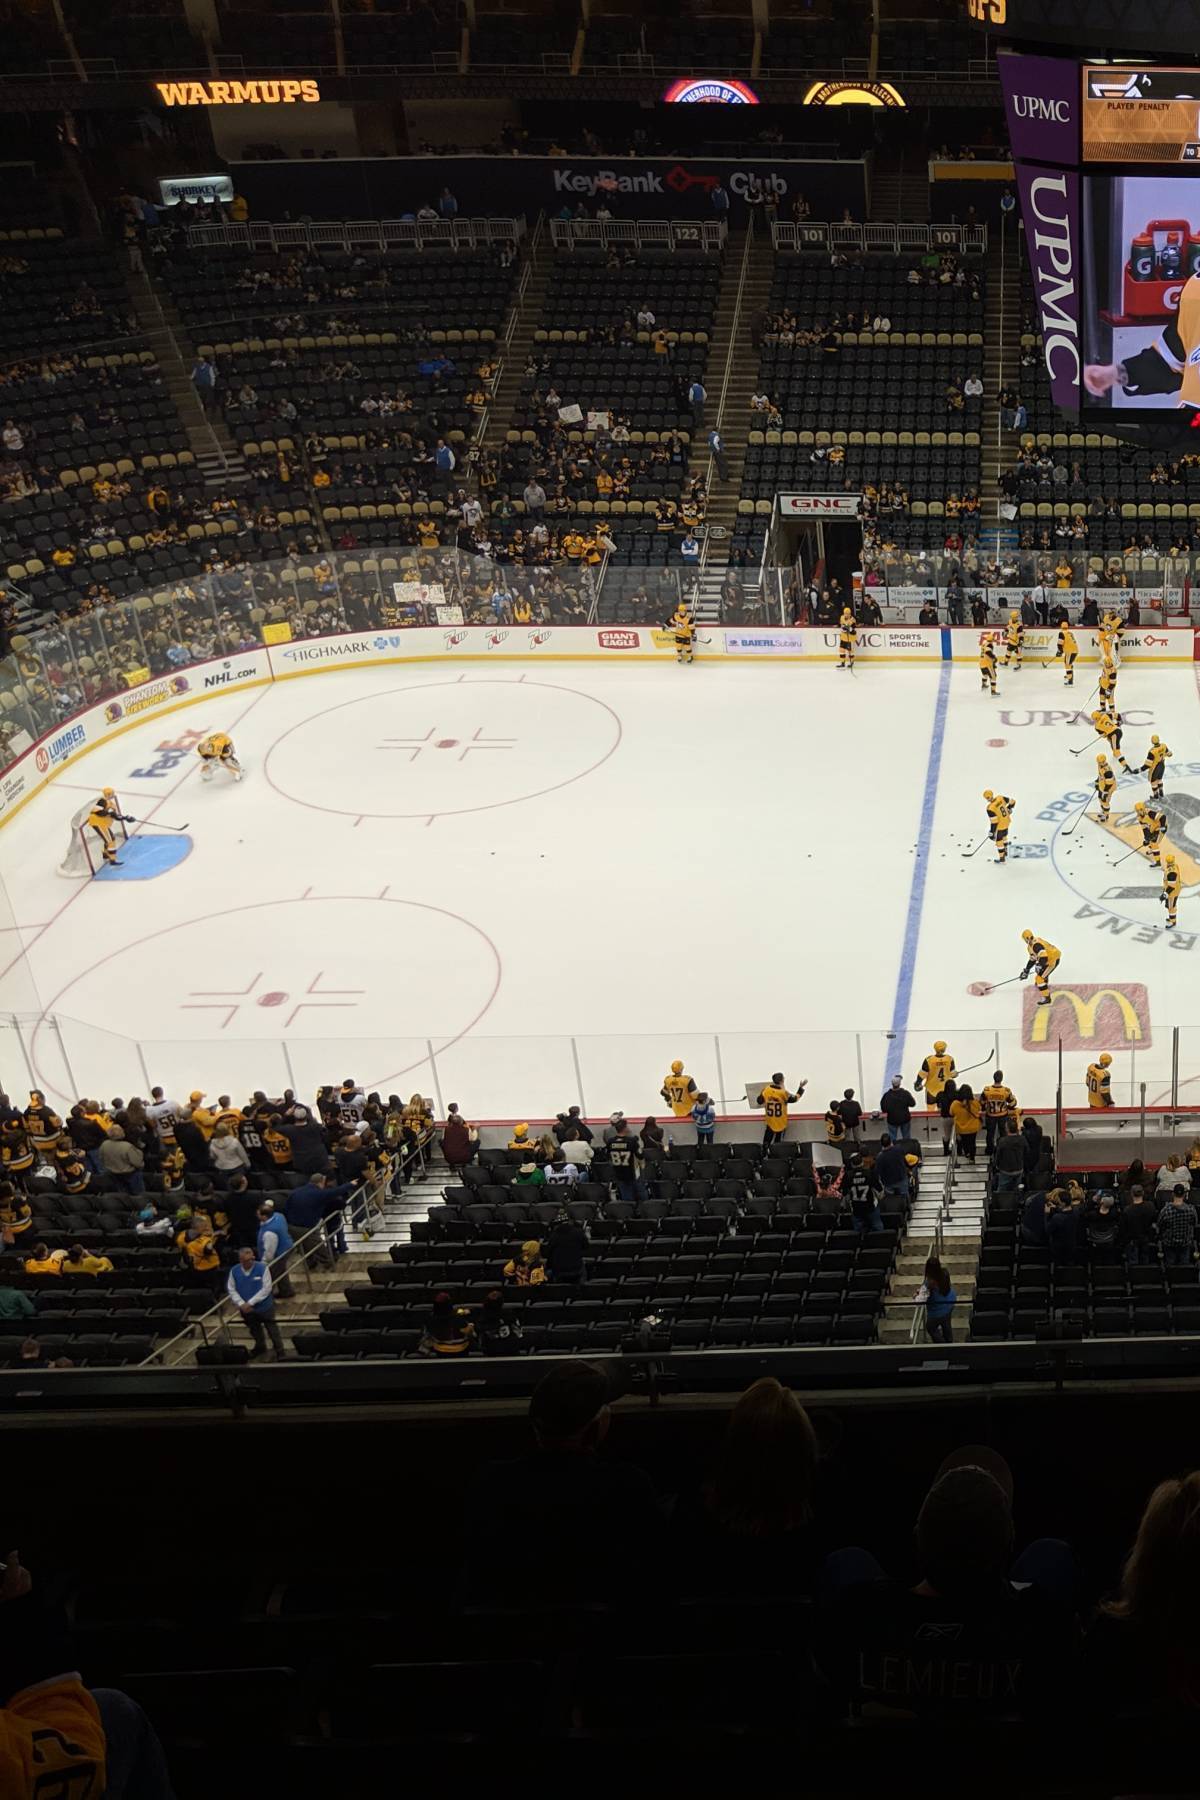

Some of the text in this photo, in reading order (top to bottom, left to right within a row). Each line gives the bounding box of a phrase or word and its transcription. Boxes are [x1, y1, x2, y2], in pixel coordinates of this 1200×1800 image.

[155, 80, 321, 107] WARMUPS
[1012, 95, 1070, 123] UPMC
[1107, 102, 1171, 111] PLAYER PENALTY
[553, 169, 664, 196] KeyBank
[674, 226, 699, 241] 122
[803, 228, 824, 242] 101
[936, 231, 957, 244] 101
[1030, 174, 1081, 386] UPMC
[791, 498, 852, 508] GNC
[603, 639, 636, 647] EAGLE
[741, 639, 803, 648] BAIERL Subaru
[823, 633, 882, 648] UMC
[889, 633, 922, 641] SPORTS
[889, 640, 930, 648] MEDICINE
[292, 640, 370, 663] HIGHMARK
[204, 667, 257, 688] NHL.COM
[49, 723, 86, 760] LUMBER
[36, 753, 49, 771] 84
[1035, 791, 1090, 823] PPG
[937, 1067, 944, 1082] 4
[342, 1109, 358, 1122] 59
[767, 1102, 782, 1118] 58
[158, 1114, 177, 1130] 58
[242, 1134, 262, 1149] 18
[610, 1150, 631, 1167] 87
[851, 1185, 869, 1200] 17
[857, 1648, 1023, 1698] LEMIEUX
